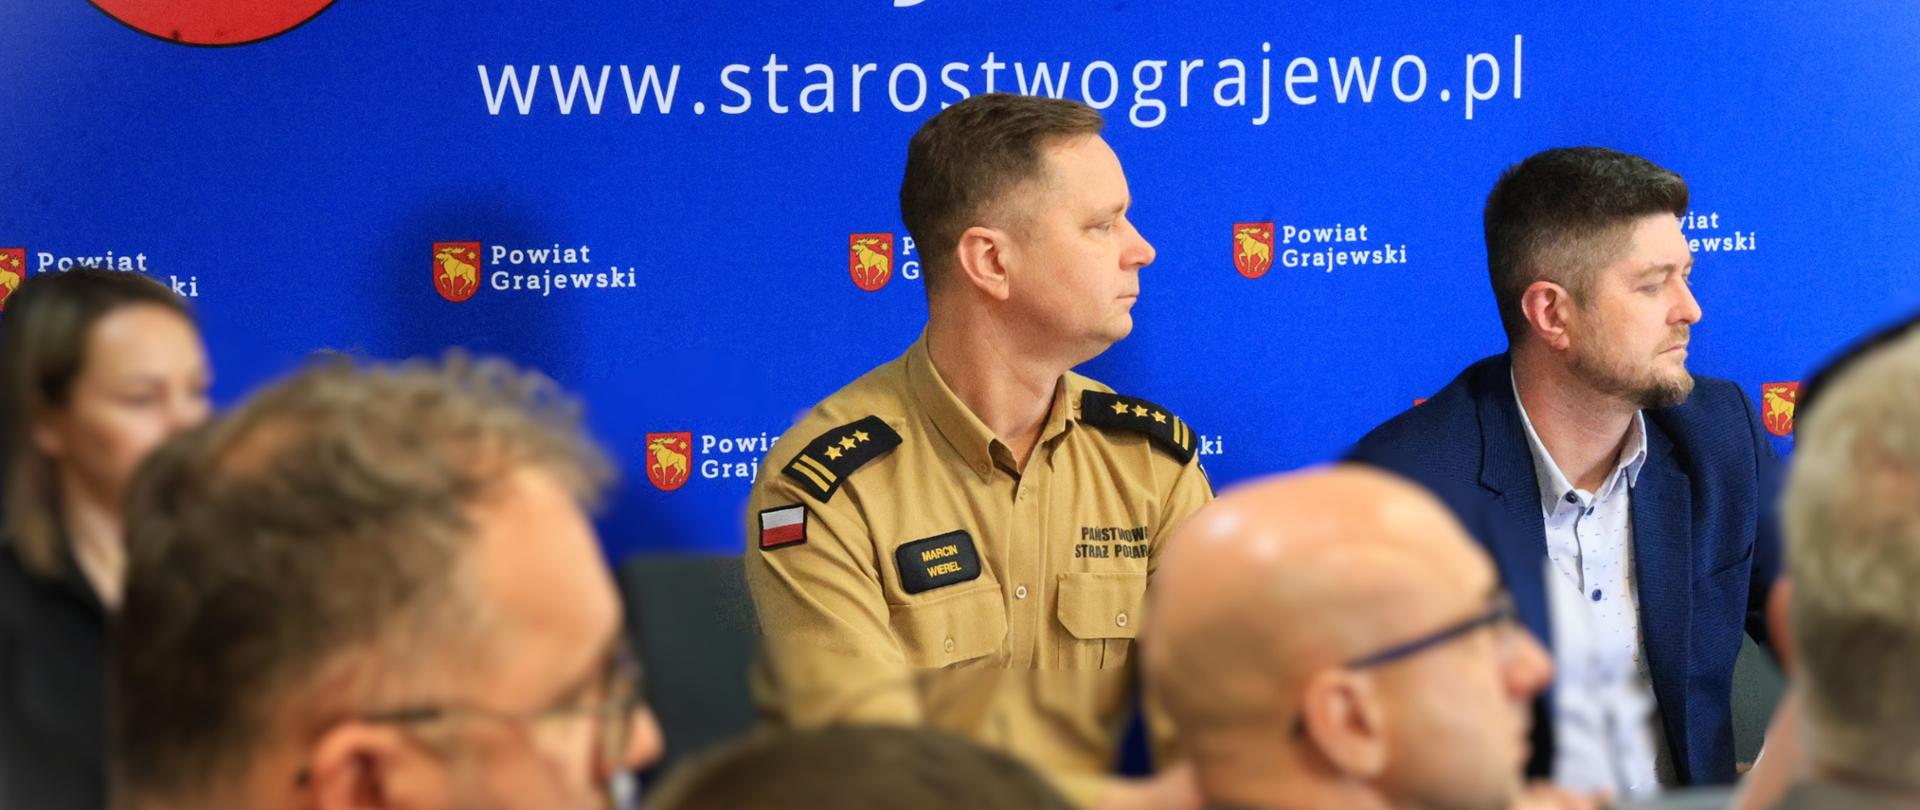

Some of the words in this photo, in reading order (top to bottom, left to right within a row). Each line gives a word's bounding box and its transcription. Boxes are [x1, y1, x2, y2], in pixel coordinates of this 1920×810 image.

[477, 34, 1523, 128] www.starostwograjewo.pl
[1282, 223, 1368, 244] Powiat
[37, 250, 147, 273] Powiat
[491, 243, 590, 265] Powiat
[1282, 243, 1407, 273] Grajewski
[490, 266, 637, 297] Grajewski
[701, 431, 780, 454] Powi
[921, 544, 959, 562] MARCIN
[926, 560, 963, 578] WIEREL
